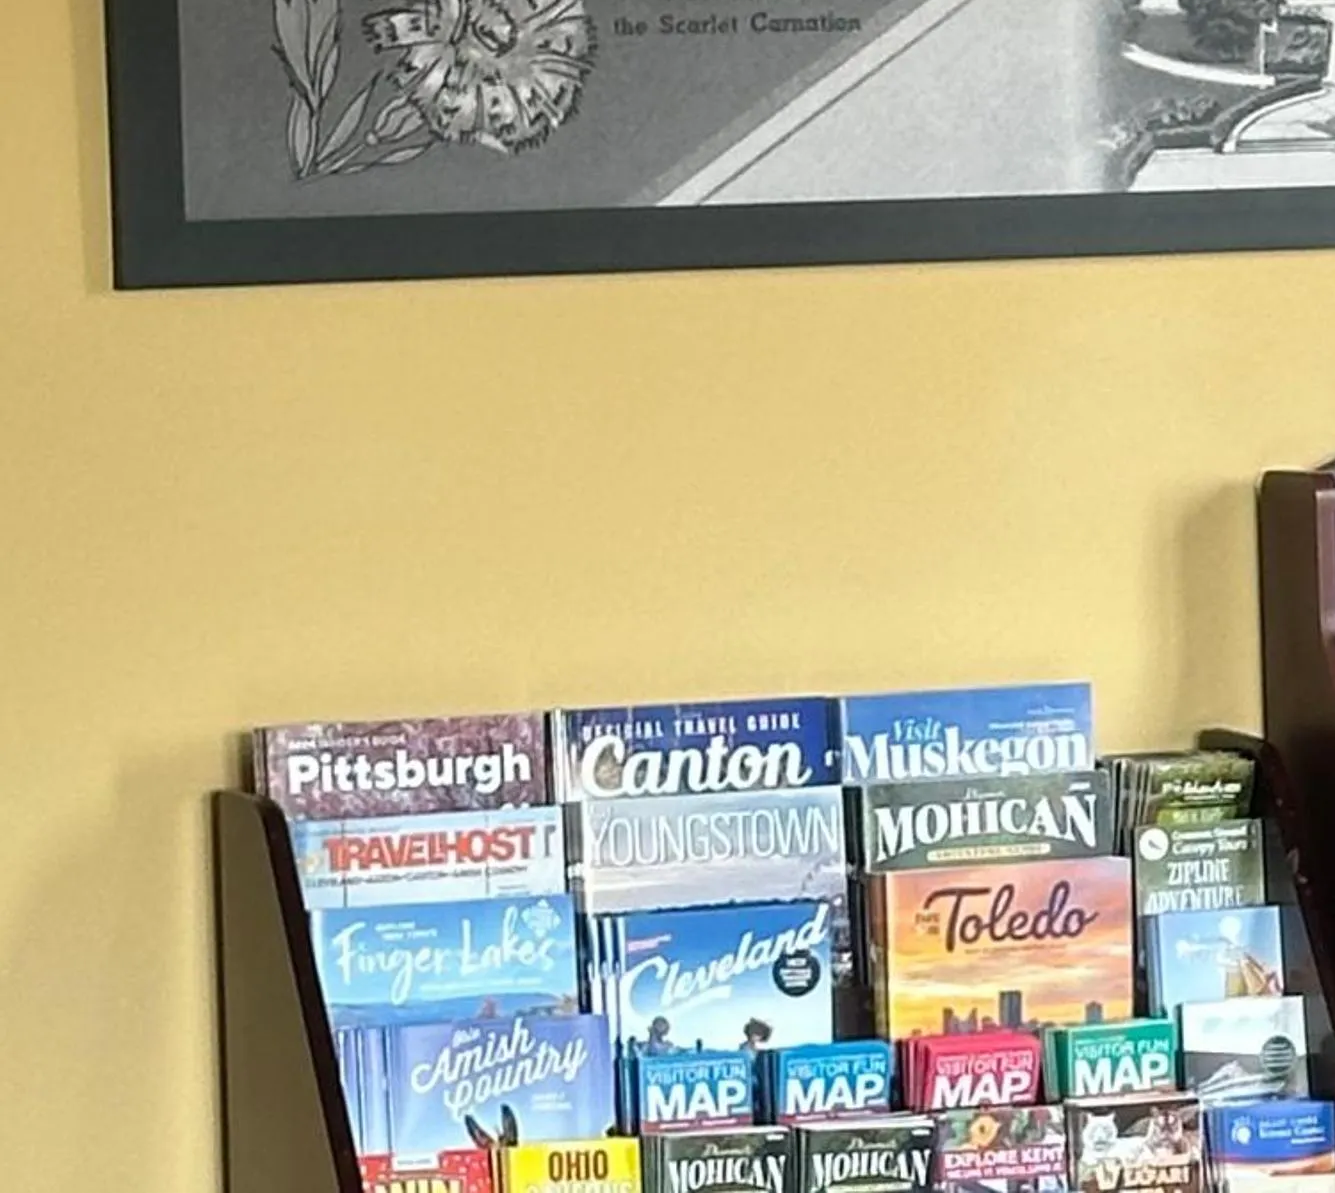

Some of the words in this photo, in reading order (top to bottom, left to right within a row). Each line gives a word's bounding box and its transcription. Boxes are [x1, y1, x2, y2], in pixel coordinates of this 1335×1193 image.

[614, 17, 648, 36] the
[659, 14, 738, 35] Scarlet
[750, 11, 861, 34] Carnation
[583, 721, 664, 741] OFFICIAL
[674, 716, 736, 736] TRAVEL
[747, 712, 801, 731] GUIDE
[891, 716, 942, 742] Visit
[287, 744, 531, 795] Pittsburgh
[580, 734, 813, 798] Canton
[845, 726, 1088, 781] Muskegon
[323, 826, 536, 873] TRAVELHOST
[589, 805, 839, 868] YOUNGSTOWN
[875, 794, 1097, 863] MOHICAN
[923, 880, 1099, 953] Toledo
[331, 921, 450, 1005] Finger
[460, 906, 555, 976] Lakes
[619, 903, 830, 1016] Cleveland
[411, 1018, 536, 1094] Amish
[1075, 1053, 1171, 1096] MAP
[444, 1038, 588, 1122] Country
[647, 1080, 747, 1123] MAP
[786, 1073, 887, 1114] MAP
[932, 1071, 1032, 1109] MAP
[548, 1148, 609, 1182] OHIO
[668, 1155, 787, 1193] MOHICAN
[811, 1149, 932, 1192] MOHICAN
